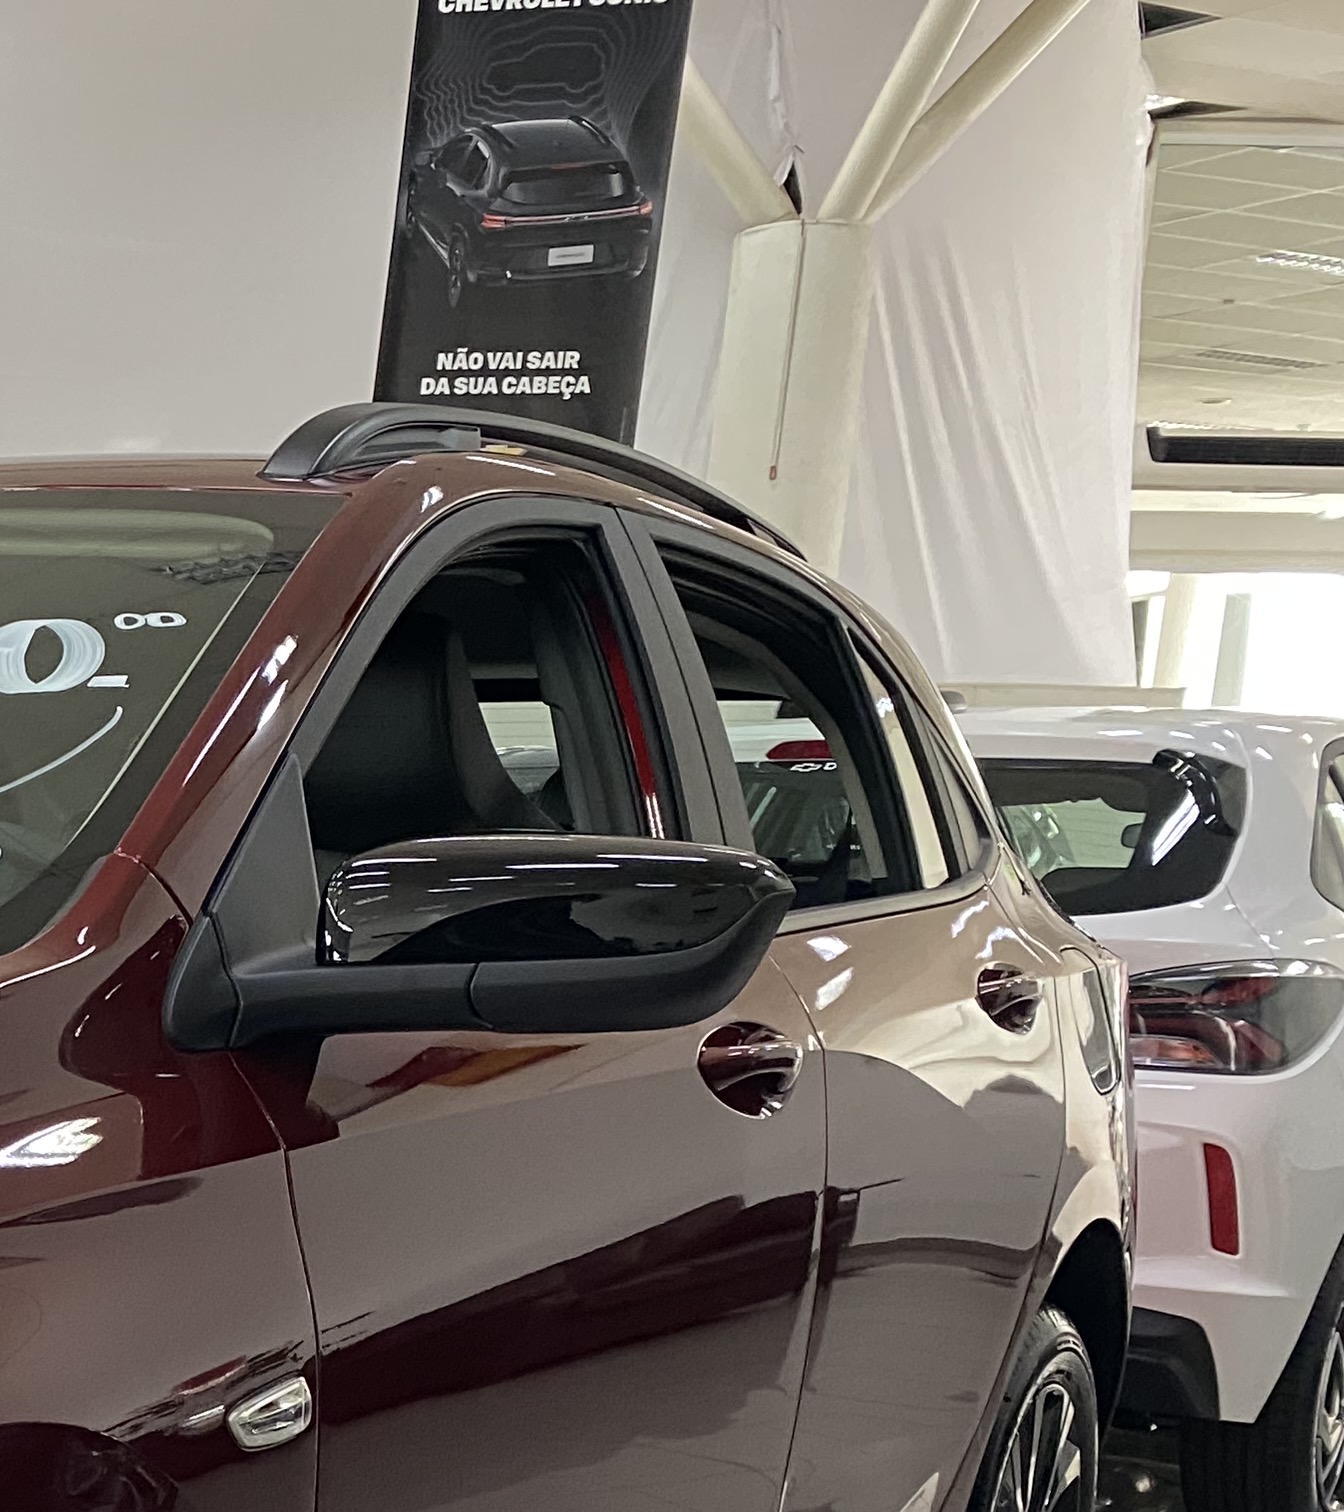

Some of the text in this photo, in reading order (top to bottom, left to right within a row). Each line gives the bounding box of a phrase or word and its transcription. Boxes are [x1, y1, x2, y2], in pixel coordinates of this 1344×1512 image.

[436, 347, 581, 371] NÃO VAI SAIR
[419, 375, 592, 401] DA SUA CABEÇA
